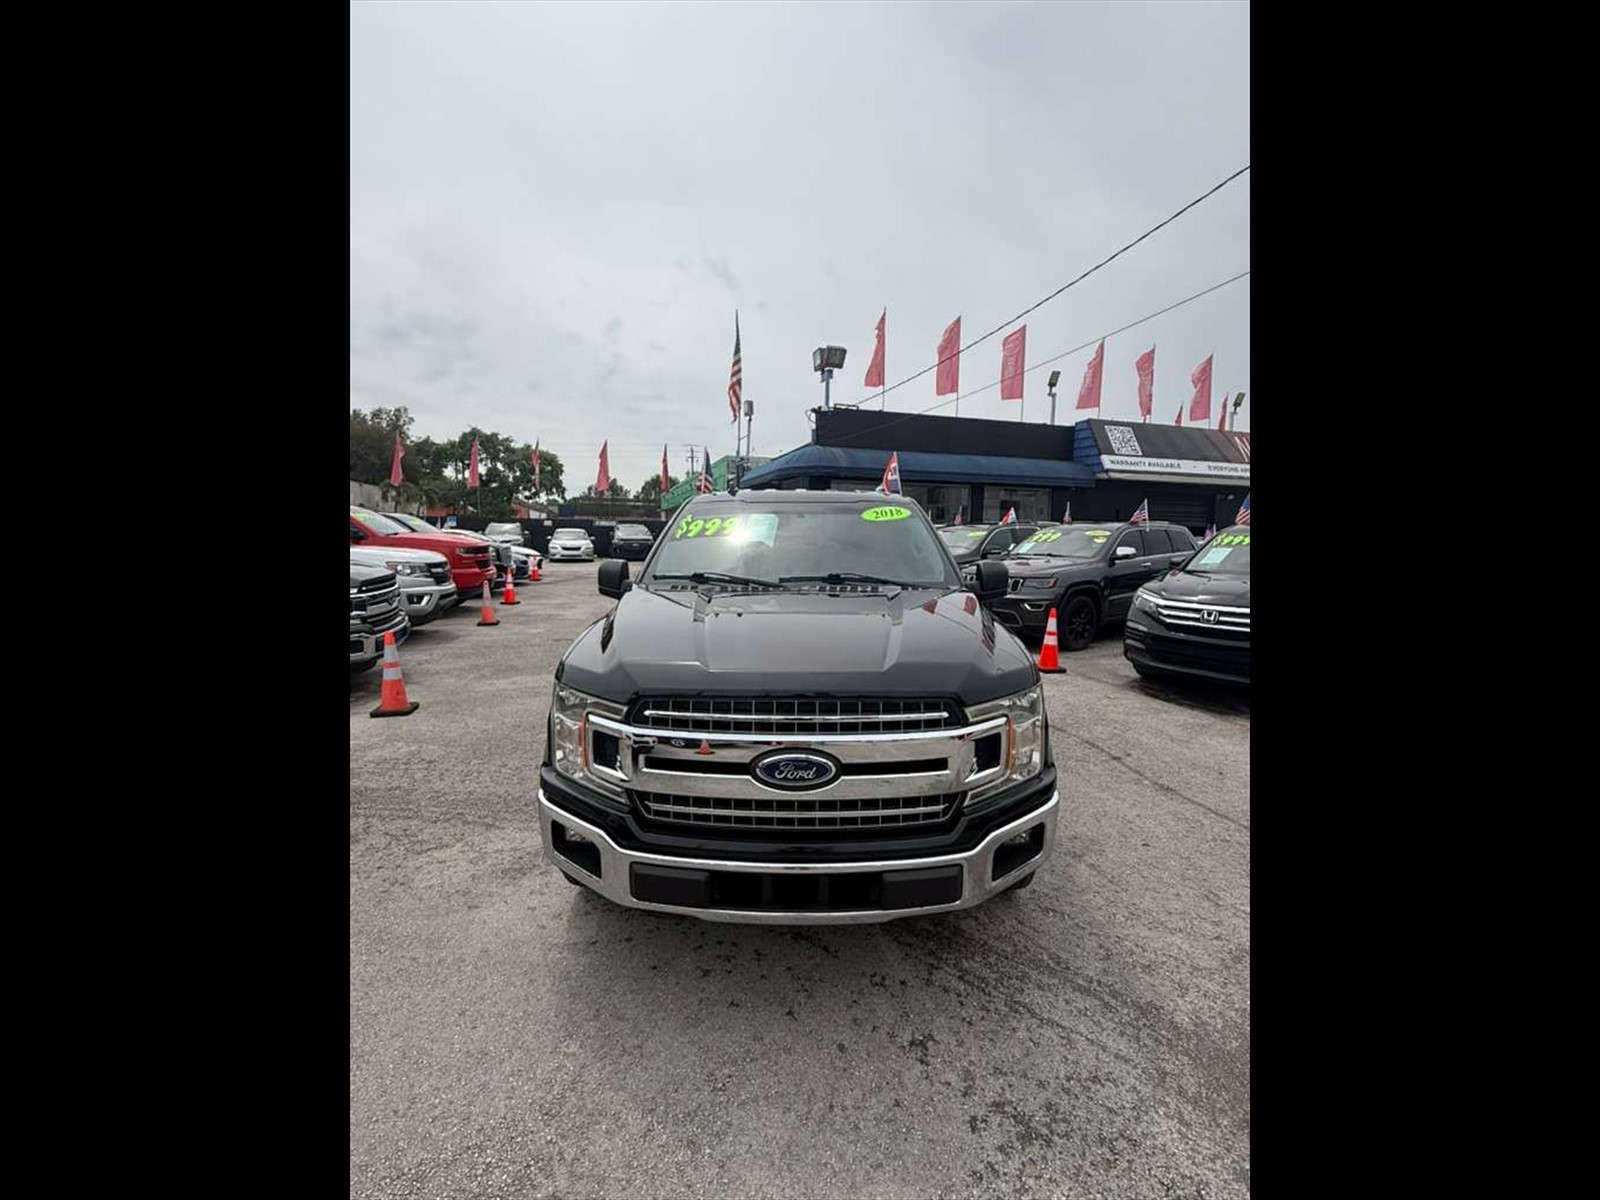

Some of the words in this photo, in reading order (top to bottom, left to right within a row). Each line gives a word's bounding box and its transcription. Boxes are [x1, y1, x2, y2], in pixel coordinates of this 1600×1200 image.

[1109, 458, 1146, 467] WARRANTY
[1148, 461, 1182, 469] AVAILABLE
[1207, 465, 1239, 473] EVERYONE
[872, 507, 903, 519] 2018
[774, 761, 817, 779] Ford
